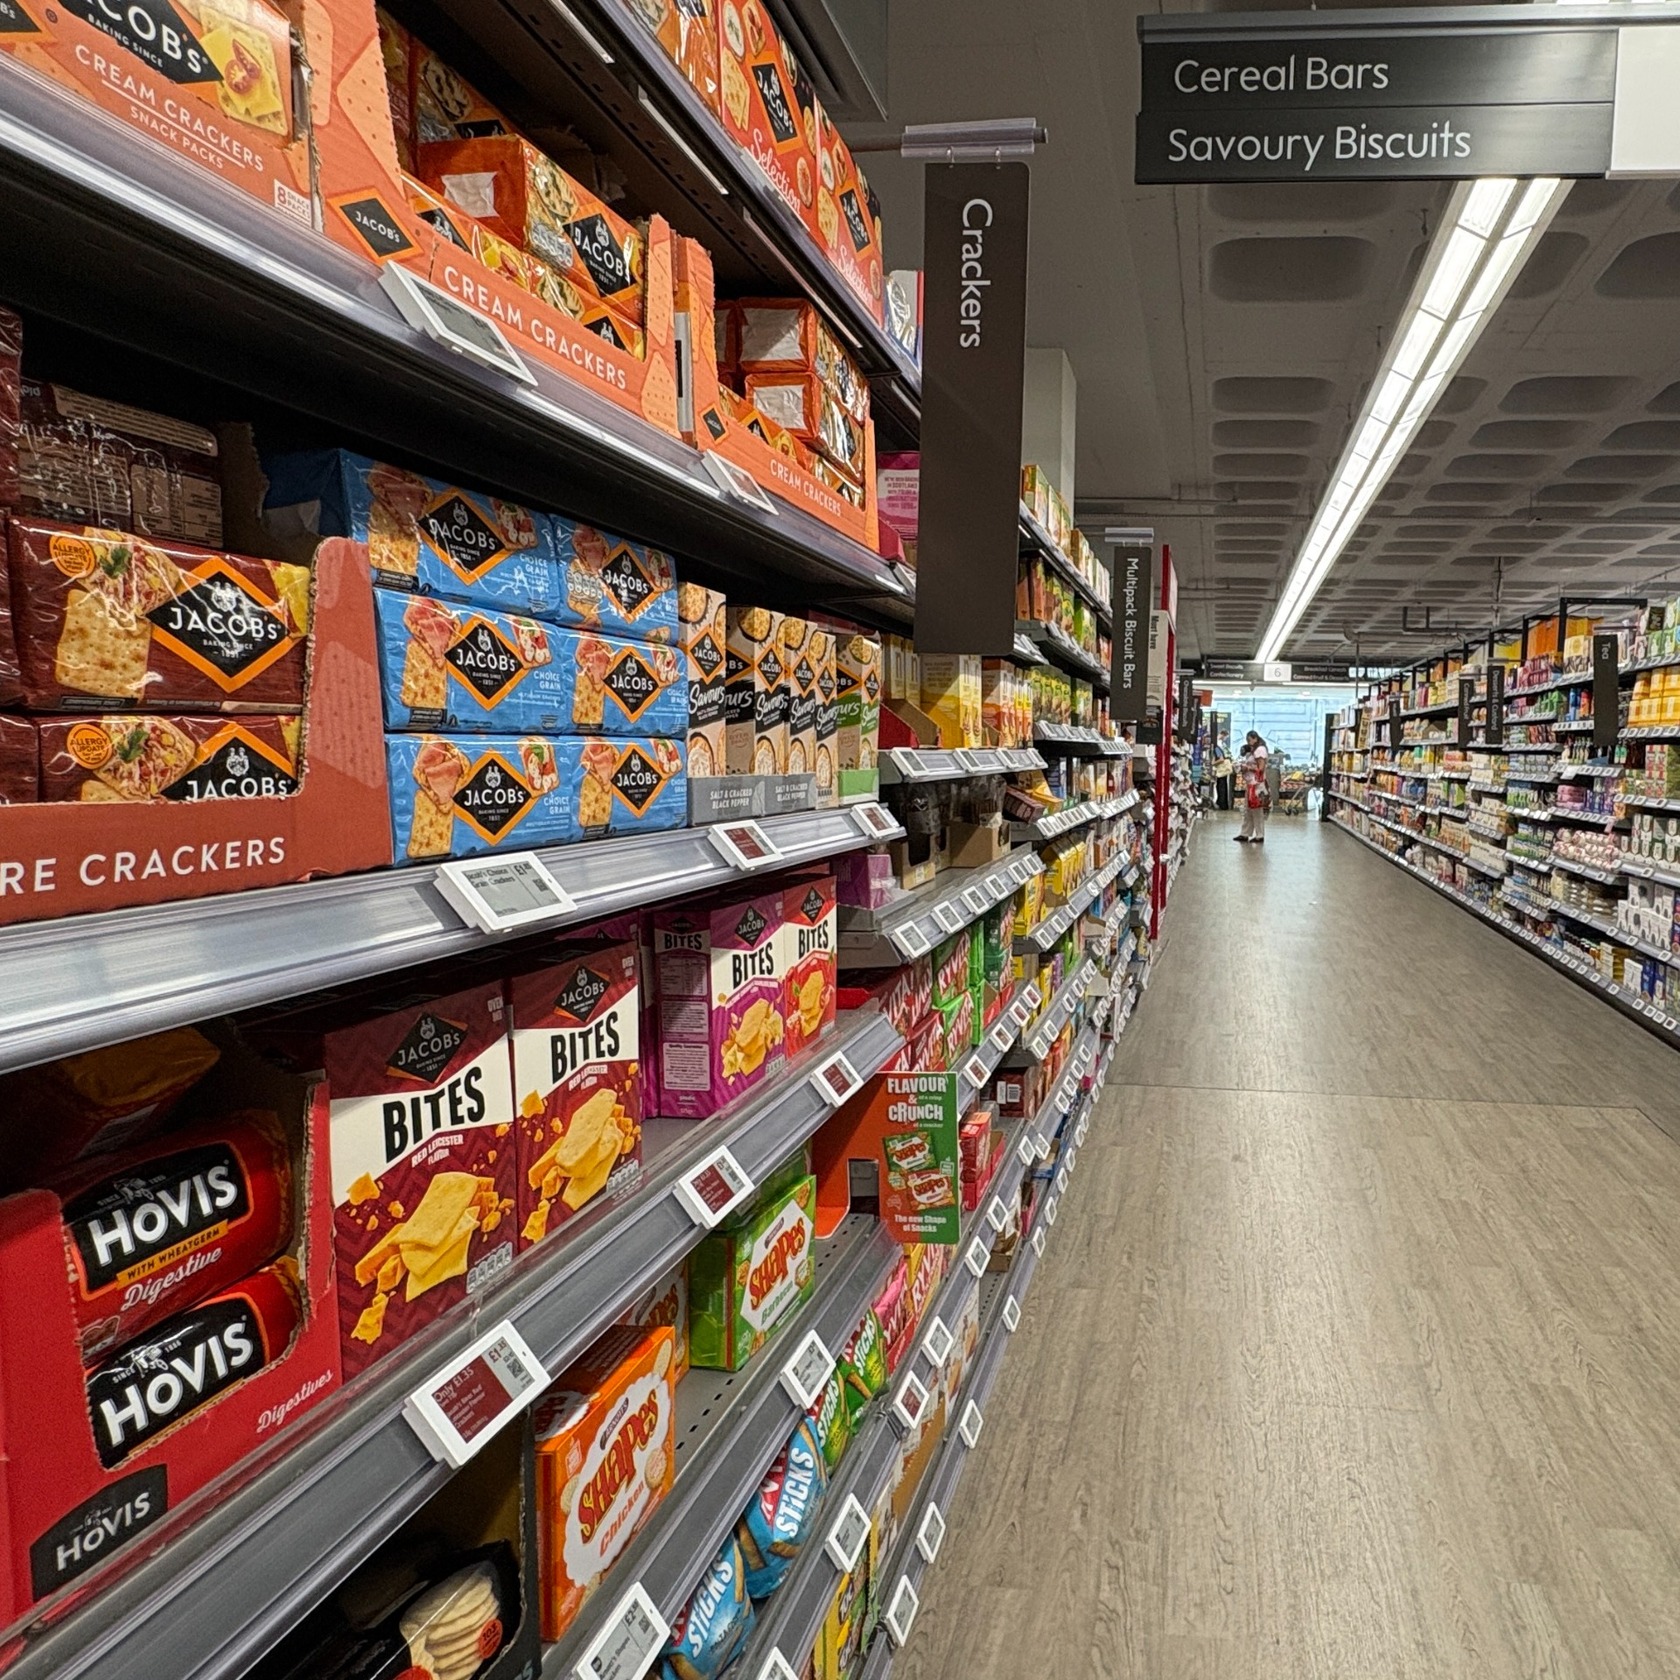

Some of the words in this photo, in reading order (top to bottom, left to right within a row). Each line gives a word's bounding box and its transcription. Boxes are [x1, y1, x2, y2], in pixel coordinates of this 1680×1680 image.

[88, 13, 130, 48] BAKING
[132, 42, 163, 68] SINCE
[1174, 54, 1295, 93] Cereal
[1306, 56, 1389, 91] Bars
[75, 44, 156, 105] CREAM
[164, 99, 264, 172] CRACKERS
[130, 105, 176, 141] SNACK
[182, 137, 224, 169] PACKS
[1168, 128, 1324, 171] Savoury
[1335, 120, 1471, 159] Biscuits
[750, 128, 801, 215] Selection
[277, 186, 286, 204] 8
[959, 198, 993, 348] Crackers
[443, 266, 523, 331] CREAM
[530, 318, 627, 390] CRACKERS
[770, 458, 802, 491] CREAM
[803, 482, 841, 517] CRACKERS
[53, 543, 90, 557] ALLERGY
[1123, 558, 1139, 617] Multipack
[1124, 619, 1137, 660] Biscuit
[1602, 643, 1611, 660] Tea
[533, 670, 561, 683] CHOICE
[539, 680, 562, 691] GRAIN
[1122, 662, 1135, 689] Bars
[1274, 667, 1281, 678] 6
[690, 683, 725, 715] Savours
[71, 737, 107, 747] ALLERGY
[543, 796, 570, 807] CHOICE
[710, 790, 723, 800] SALT
[729, 787, 753, 798] CRACKED
[712, 799, 729, 809] BLACK
[730, 798, 750, 808] PEPPER
[775, 785, 786, 794] SALT
[790, 783, 808, 792] CRACKED
[777, 792, 790, 801] BLACK
[791, 790, 806, 800] PEPPER
[549, 804, 570, 814] GRAIN
[80, 837, 286, 887] CRACKERS
[664, 933, 703, 950] BITES
[799, 919, 829, 960] BITES
[732, 941, 774, 990] BITES
[550, 1011, 620, 1086] BITES
[887, 1077, 947, 1094] FLAVOUR
[908, 1095, 918, 1105] &
[382, 1065, 486, 1164] BITES
[888, 1102, 944, 1122] CRUNCH
[411, 1146, 427, 1168] RED
[427, 1134, 464, 1155] LEICESTER
[88, 1165, 238, 1267] HOVIS
[895, 1214, 907, 1223] The
[912, 1223, 937, 1232] Snacks
[127, 1258, 155, 1280] WITH
[158, 1226, 220, 1262] WHEATGERM
[120, 1247, 222, 1312] Digestive
[100, 1322, 253, 1448] HOVIS
[111, 1368, 136, 1384] SINCE
[433, 1382, 454, 1401] Only
[455, 1366, 475, 1388] £1.35
[256, 1369, 334, 1434] Digestives
[56, 1491, 151, 1572] HOVIS
[599, 1482, 646, 1558] Chicken
